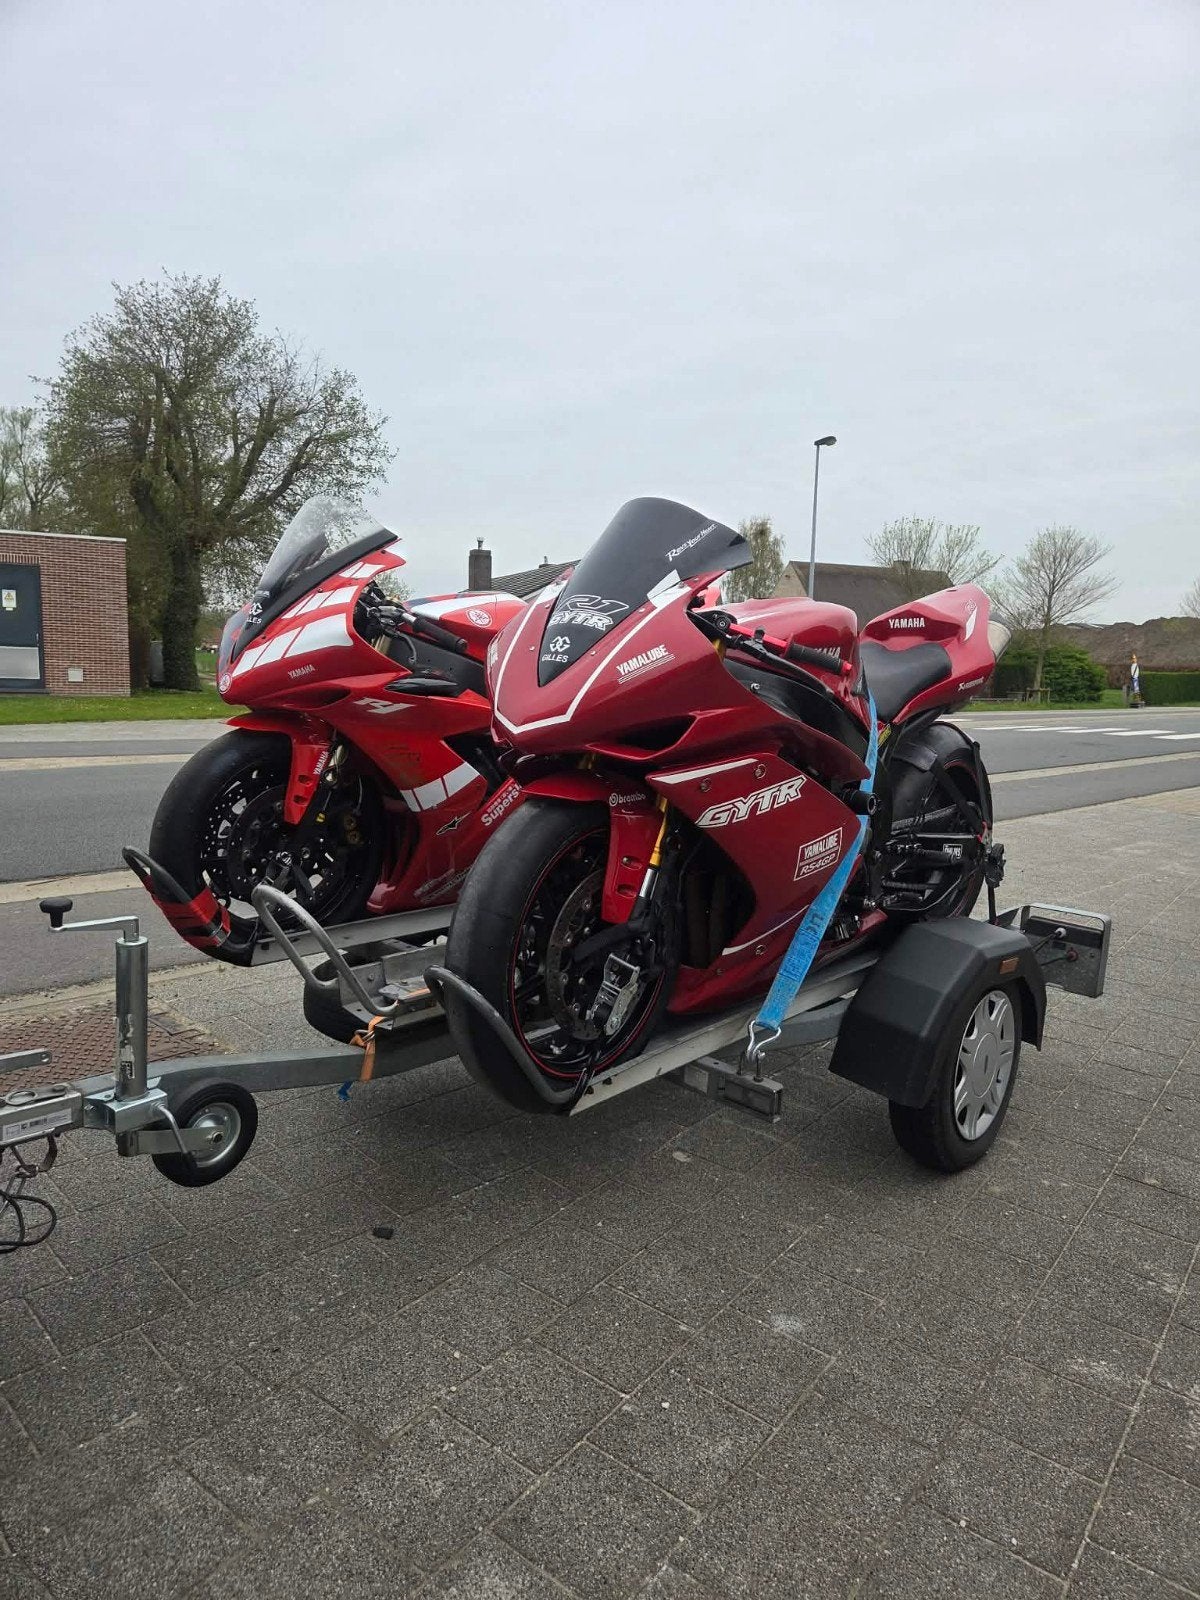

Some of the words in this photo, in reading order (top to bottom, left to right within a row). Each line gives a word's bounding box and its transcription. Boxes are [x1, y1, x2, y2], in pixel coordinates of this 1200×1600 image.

[547, 610, 614, 631] GYTR
[889, 618, 926, 629] YAMAHA
[541, 653, 569, 663] GILLES
[616, 644, 669, 676] YAMALUBE
[287, 664, 316, 679] YAMAHA
[313, 750, 329, 775] YAMAHA
[695, 775, 807, 828] GYTR
[804, 833, 839, 860] YAMALUBE
[800, 852, 836, 874] RS4GP
